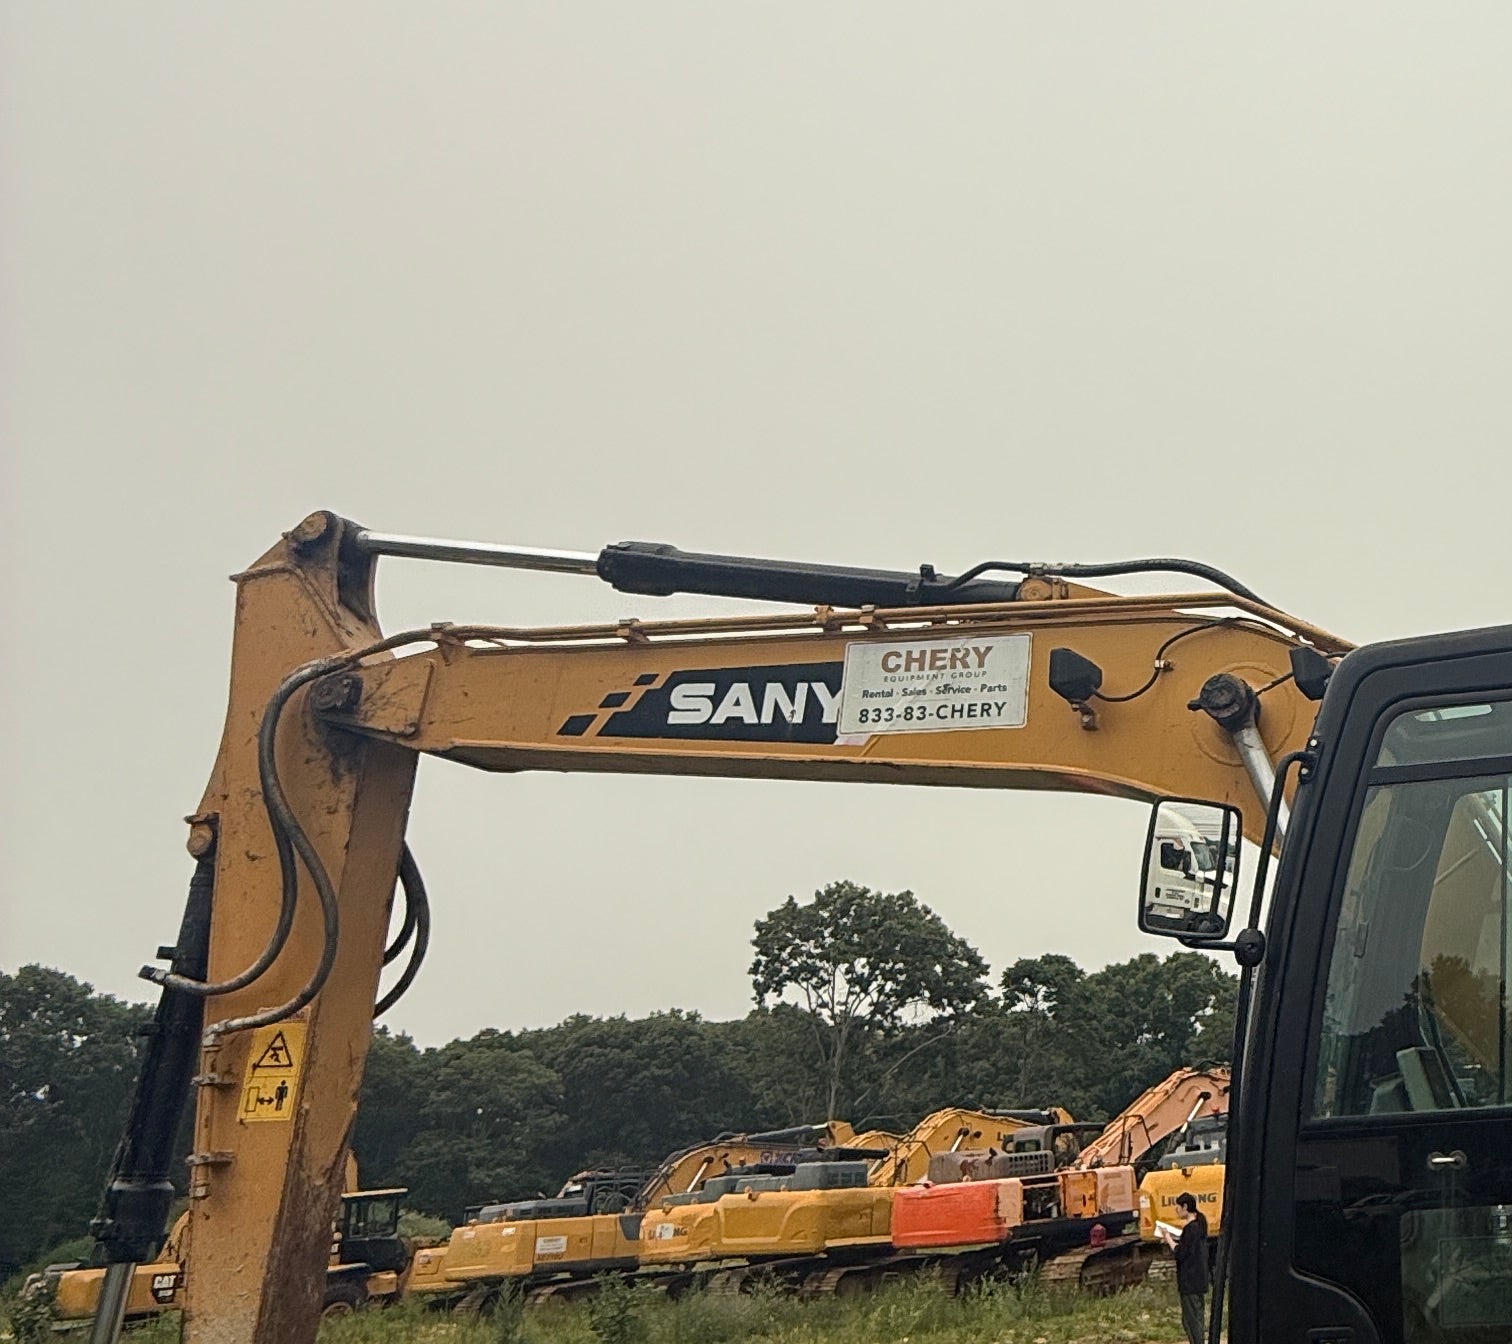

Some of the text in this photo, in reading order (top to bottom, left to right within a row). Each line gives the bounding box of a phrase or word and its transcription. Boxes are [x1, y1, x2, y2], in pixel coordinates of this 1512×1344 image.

[881, 646, 993, 673] CHERY
[883, 670, 988, 683] EQUIPMENT GROUP
[861, 683, 1008, 699] Rental Sales Service Parts
[858, 701, 1008, 724] 833-83-CHERY
[153, 1275, 177, 1289] CAT
